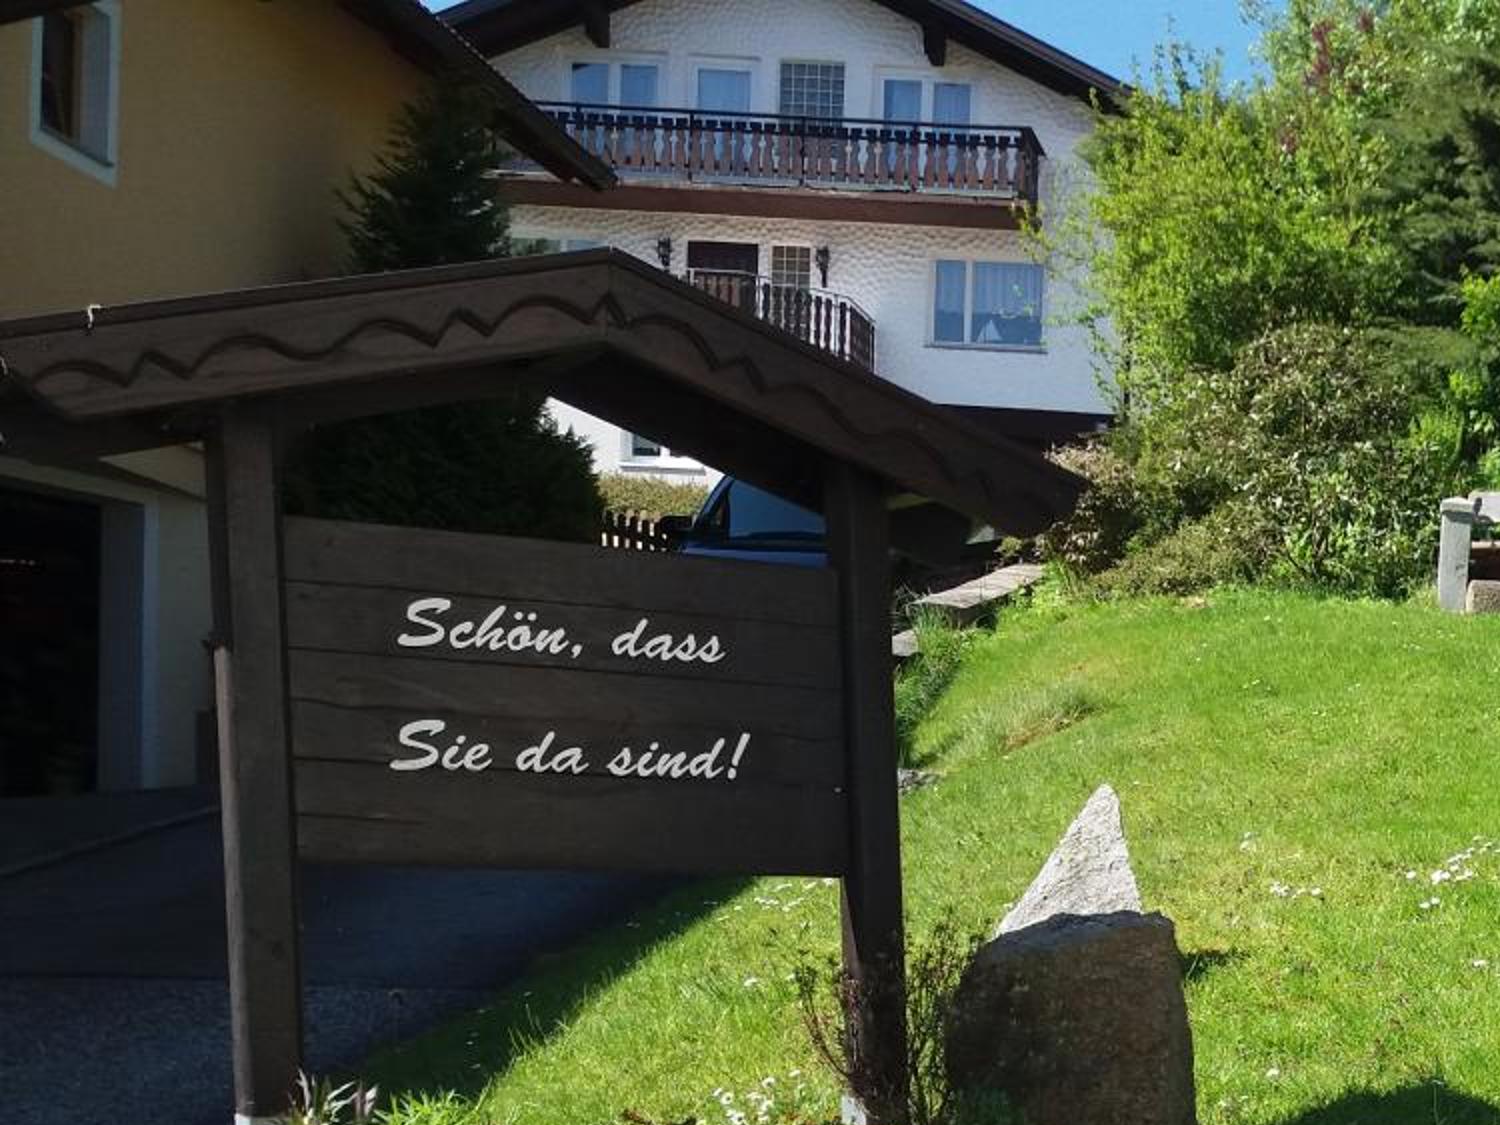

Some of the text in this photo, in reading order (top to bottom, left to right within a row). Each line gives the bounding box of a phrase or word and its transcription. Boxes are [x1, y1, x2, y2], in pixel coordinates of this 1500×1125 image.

[396, 597, 726, 663] Schön, dass
[389, 719, 752, 779] Sie da sind!
